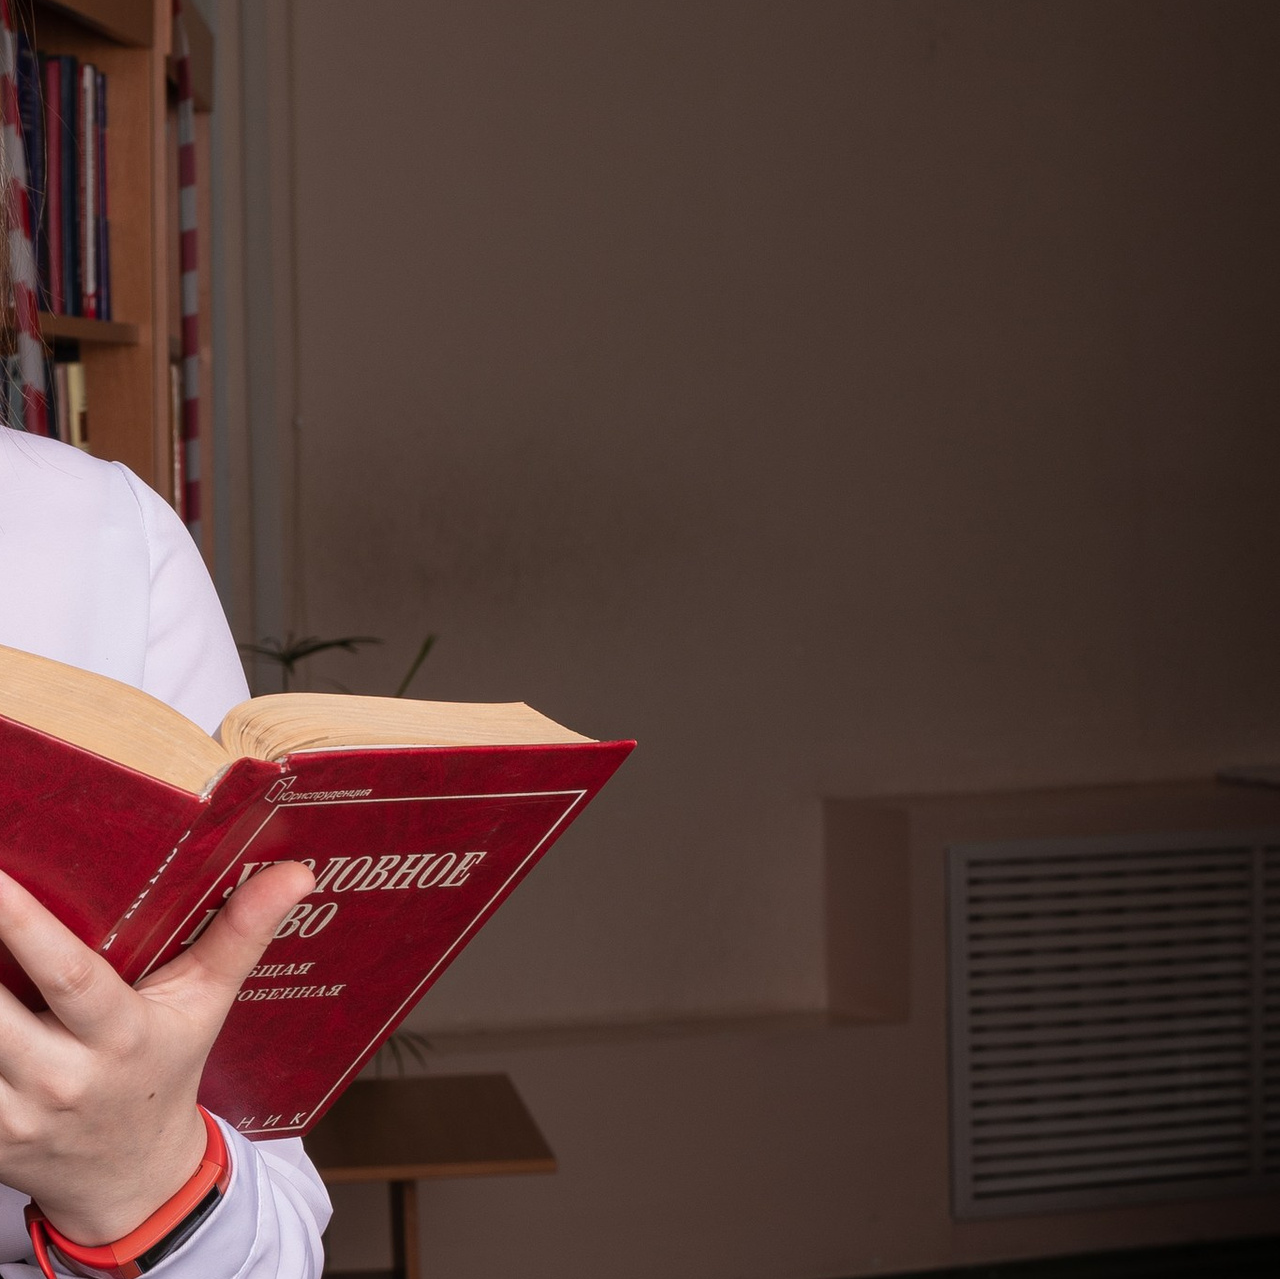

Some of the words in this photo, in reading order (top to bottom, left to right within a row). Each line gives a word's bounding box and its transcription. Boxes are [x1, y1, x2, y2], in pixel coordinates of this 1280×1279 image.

[277, 788, 372, 802] Юриспруденция
[247, 962, 316, 979] БЩАЯ
[236, 984, 346, 1002] ОБЕННАЯ
